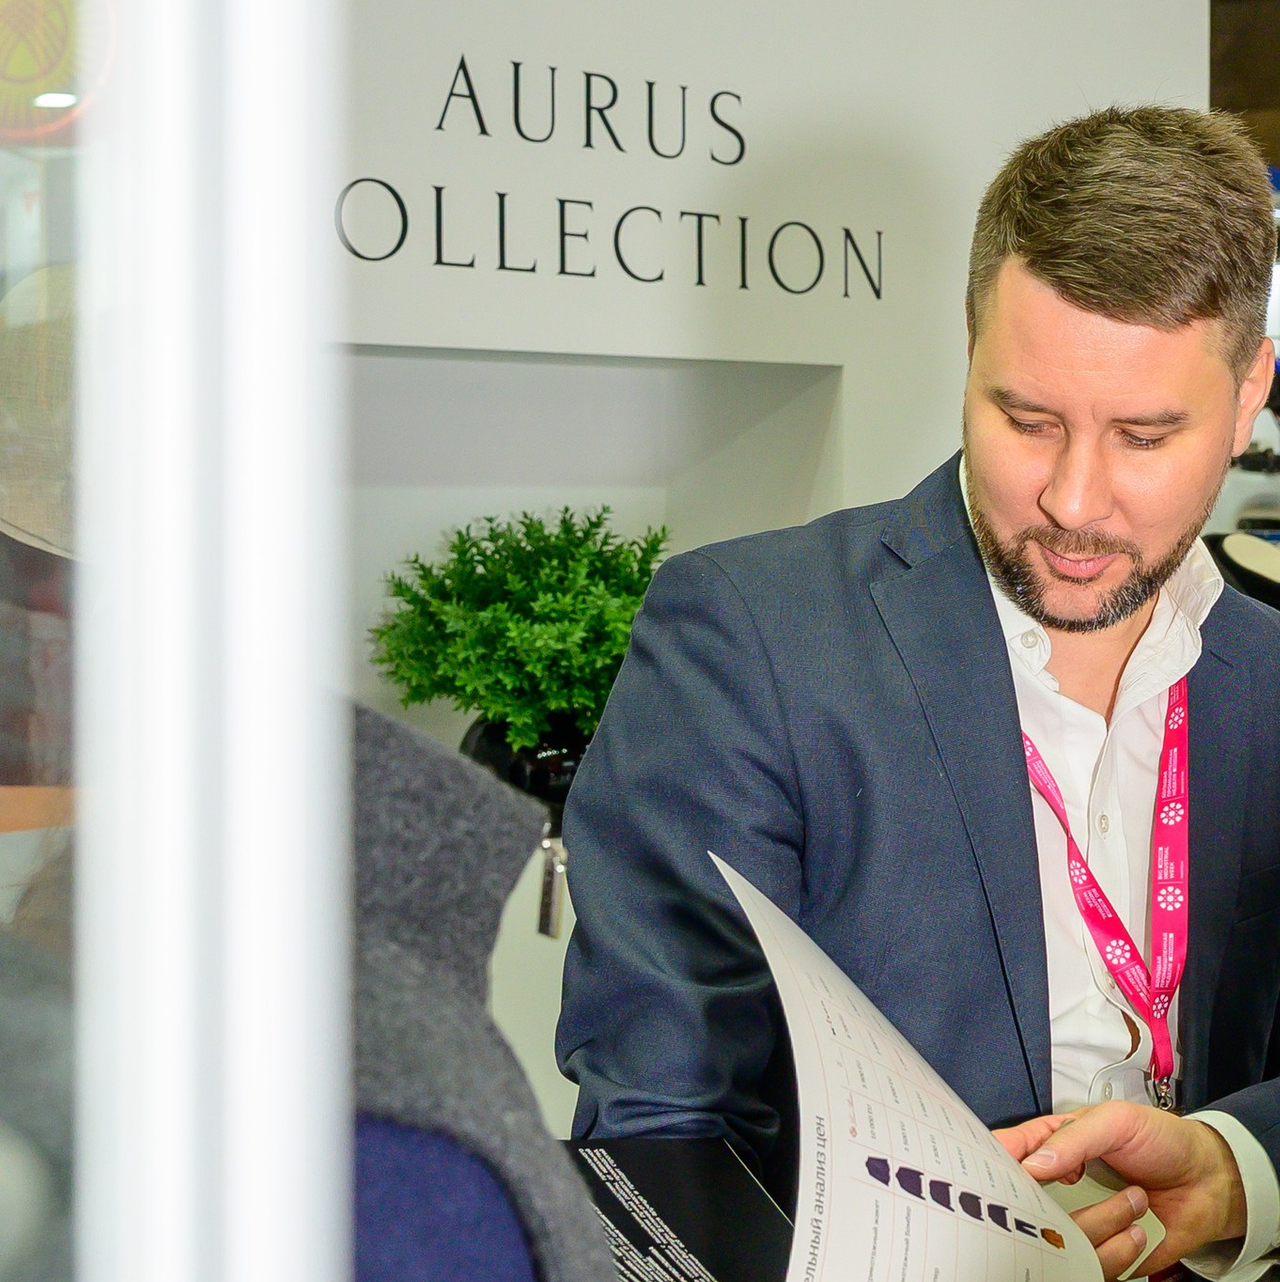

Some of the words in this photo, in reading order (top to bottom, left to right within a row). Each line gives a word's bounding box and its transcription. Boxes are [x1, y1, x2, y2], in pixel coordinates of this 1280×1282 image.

[435, 54, 746, 165] AURUS
[334, 177, 884, 300] OLLECTION
[1091, 888, 1100, 898] BIG
[1154, 956, 1163, 987] БОЛЬШАЯ
[1160, 933, 1168, 987] ПРОМЫШЛЕННАЯ
[813, 1115, 827, 1149] цен
[813, 1151, 827, 1215] анализ
